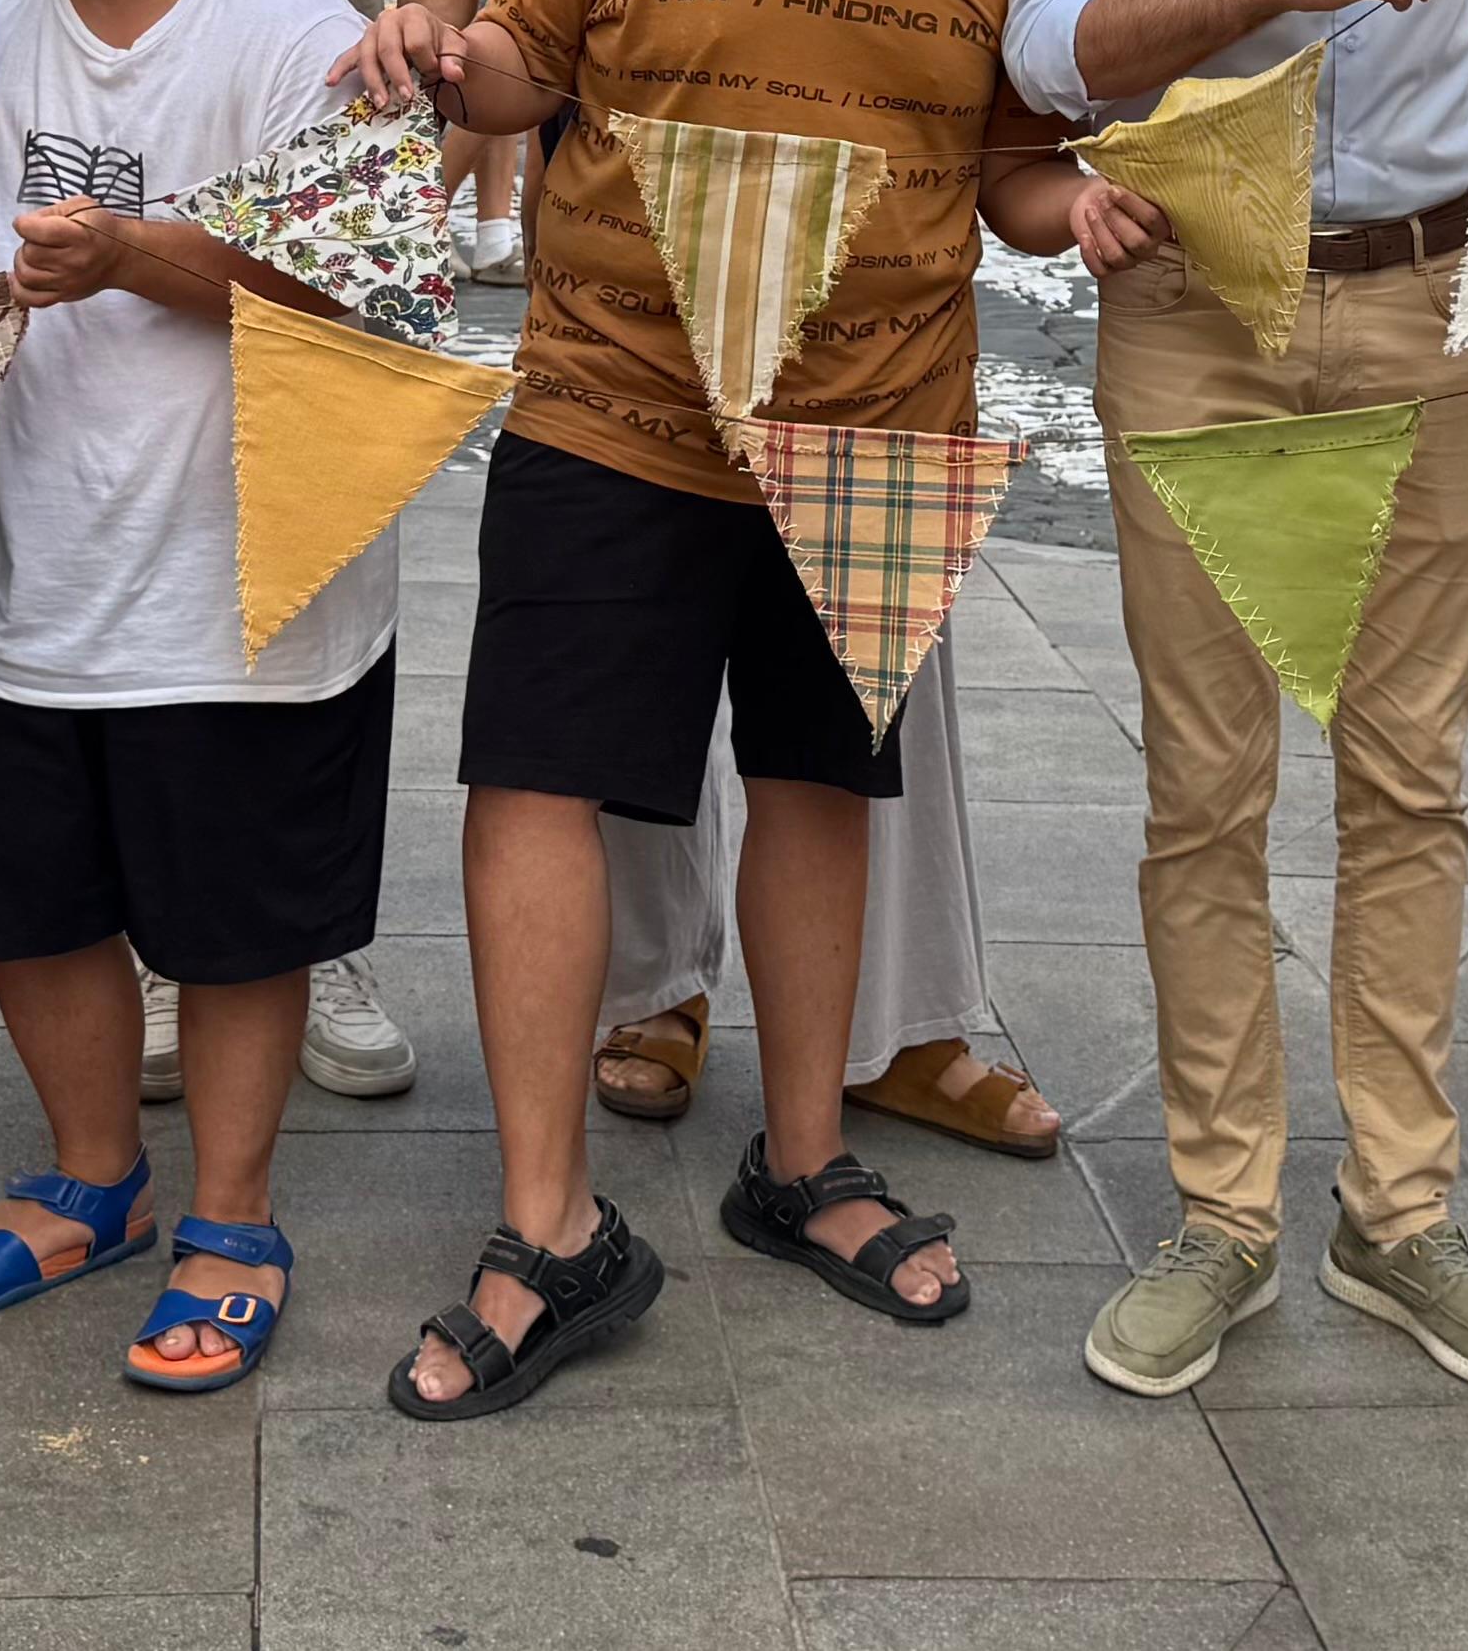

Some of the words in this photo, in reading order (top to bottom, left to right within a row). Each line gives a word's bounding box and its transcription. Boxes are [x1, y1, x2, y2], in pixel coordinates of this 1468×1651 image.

[631, 69, 711, 86] FINDING
[719, 73, 759, 91] MY
[765, 80, 833, 104] SOUL
[858, 93, 947, 117] LOSING
[905, 168, 951, 190] MY
[845, 253, 913, 270] OSING
[546, 268, 590, 294] MY
[800, 320, 877, 344] SING
[622, 408, 693, 443] MY
